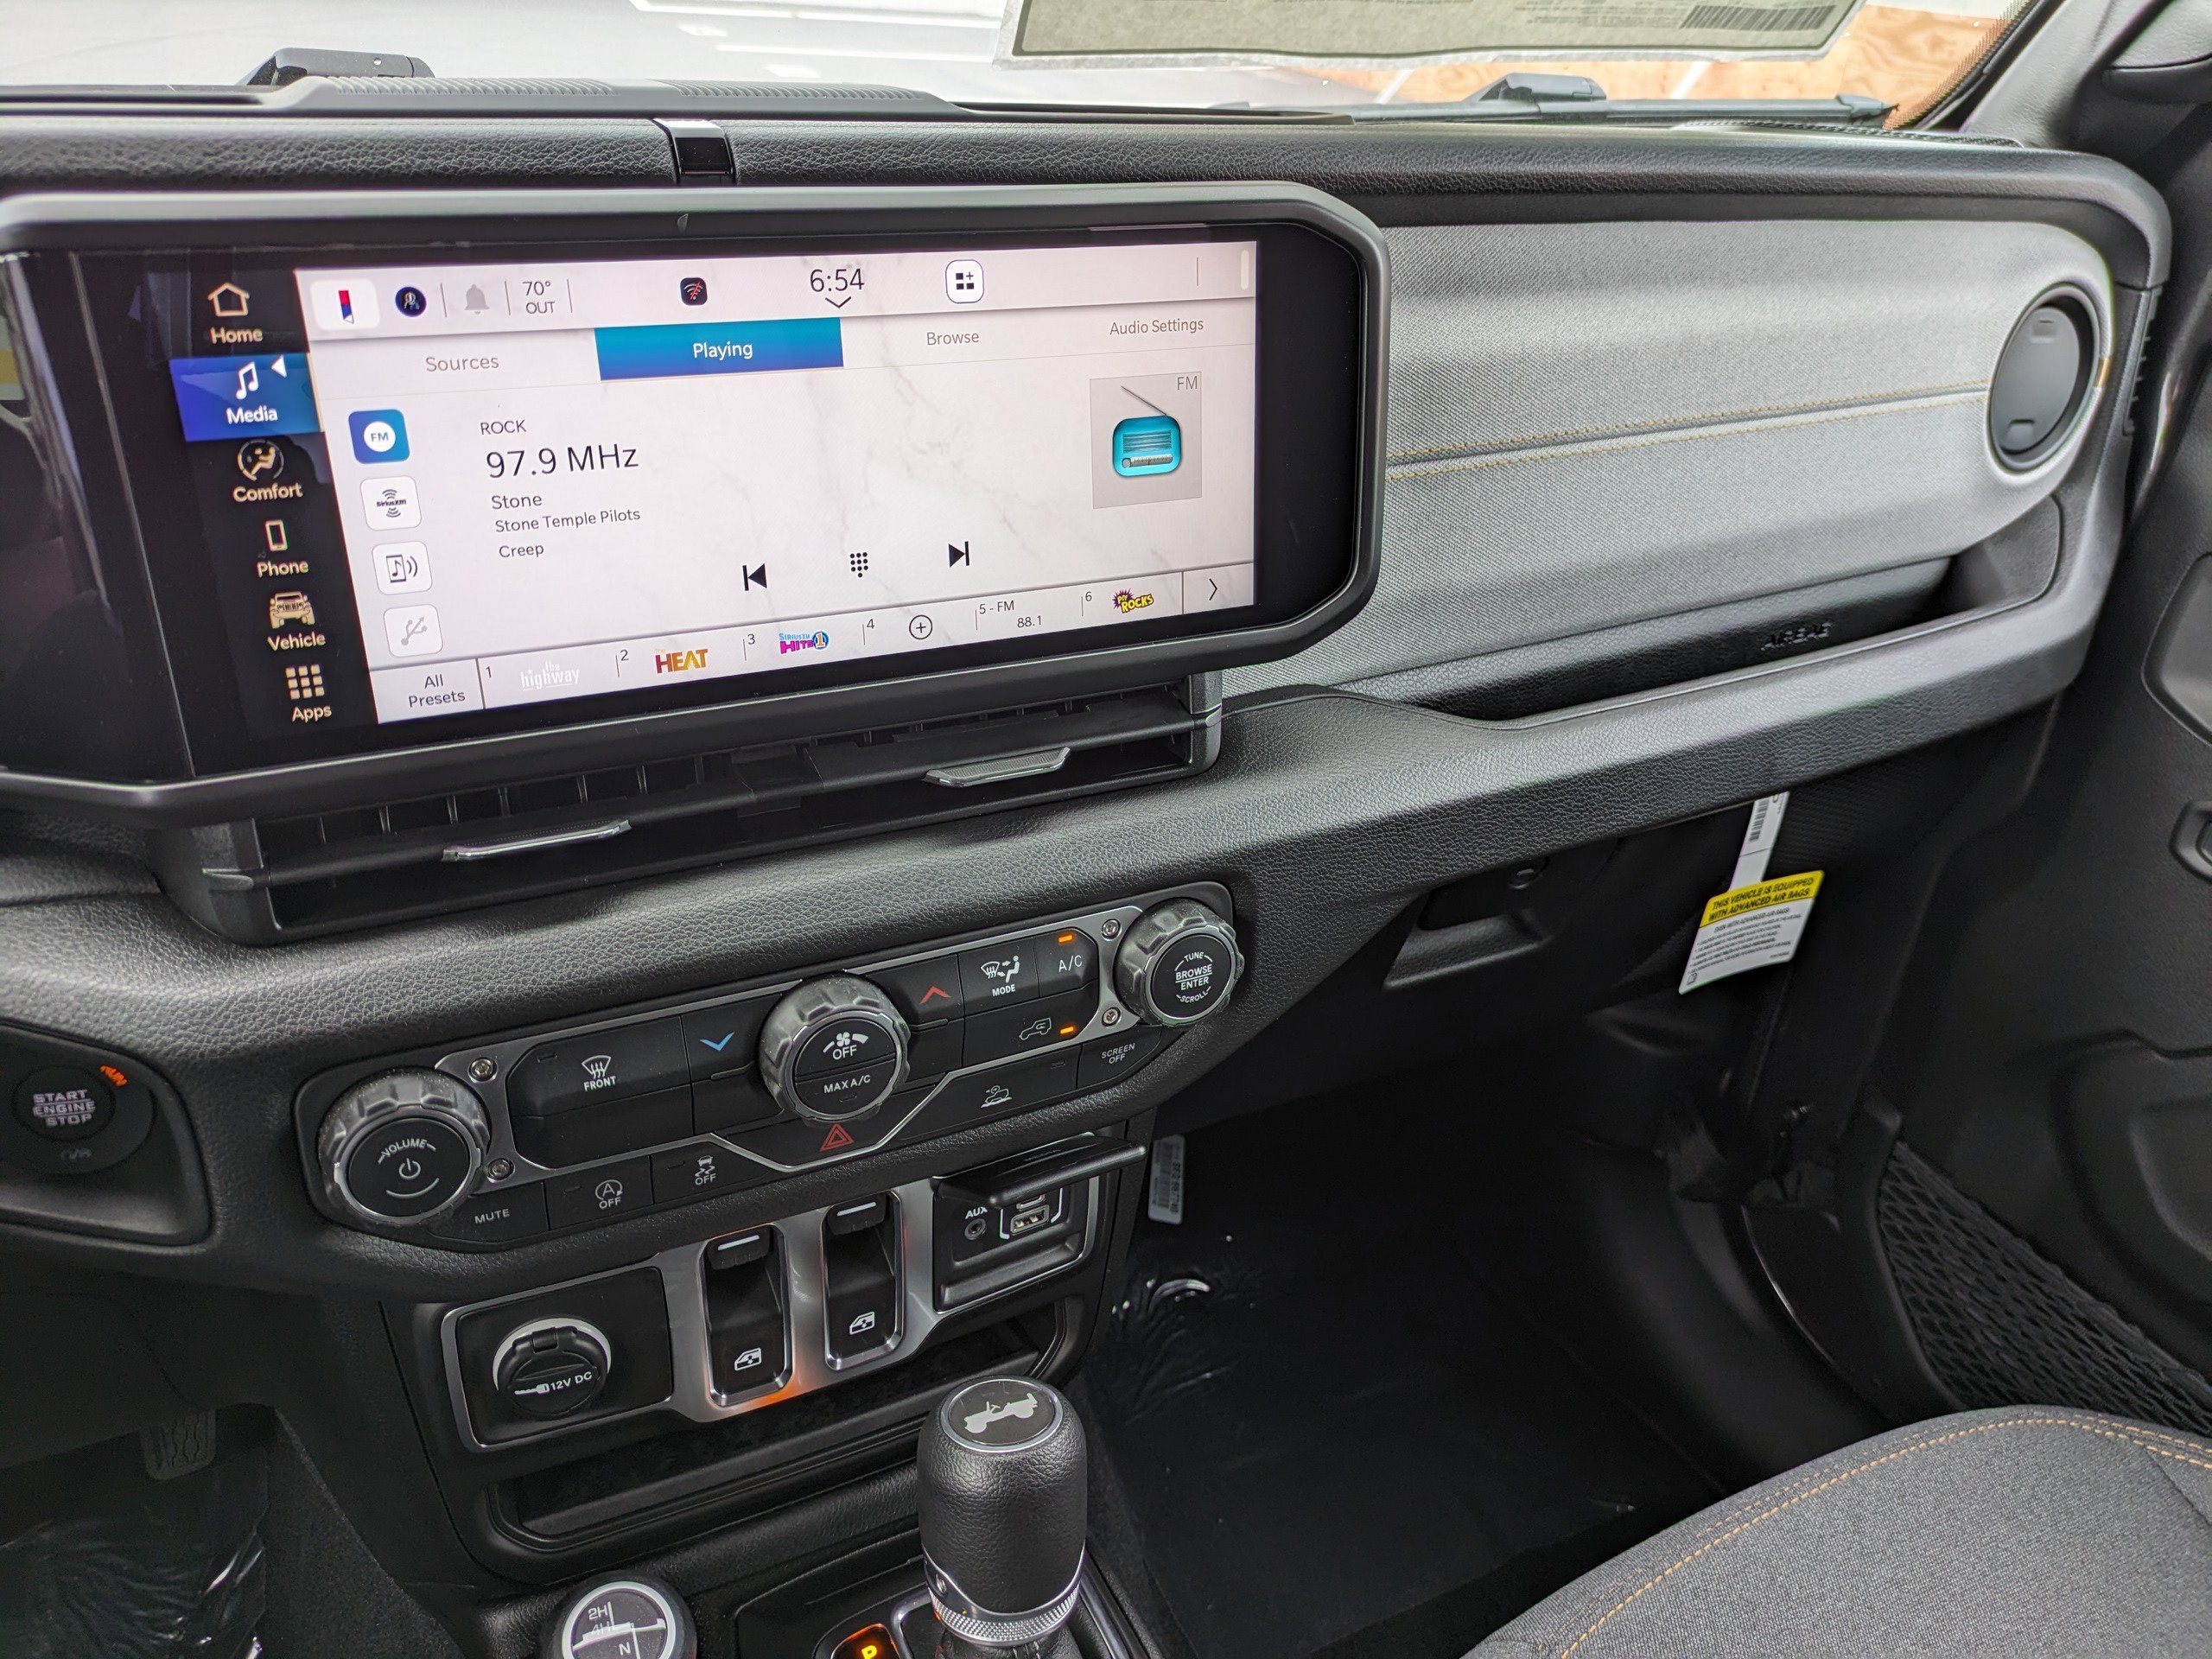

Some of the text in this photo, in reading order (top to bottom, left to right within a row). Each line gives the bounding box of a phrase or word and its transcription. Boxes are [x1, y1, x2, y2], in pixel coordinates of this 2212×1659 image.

[810, 268, 864, 292] 6:54
[525, 301, 556, 315] OUT
[1109, 317, 1205, 335] Audio Settings
[211, 327, 263, 344] Home
[926, 331, 980, 346] Browse
[692, 341, 753, 360] Playing
[425, 353, 499, 372] Sources
[1177, 376, 1198, 391] FM
[226, 406, 278, 424] Media
[480, 418, 527, 435] ROCK
[371, 432, 389, 442] FM
[486, 443, 639, 479] 97.9 MHz
[232, 482, 303, 503] Comfort
[491, 493, 543, 510] Stone
[495, 506, 641, 533] Stone Temple Pilots
[499, 543, 544, 560] Creep
[257, 558, 309, 577] Phone
[1085, 591, 1092, 601] 6
[1121, 594, 1154, 613] ROCKS
[979, 603, 987, 615] 5
[997, 601, 1014, 613] FM
[866, 619, 875, 631] 4
[1017, 615, 1042, 628] 88.1
[267, 632, 326, 652] Vehicle
[747, 633, 756, 645] 3
[815, 632, 824, 649] 1
[620, 649, 629, 661] 2
[655, 649, 708, 674] HEAT
[485, 666, 493, 679] 1
[545, 660, 560, 672] the
[424, 674, 444, 689] All
[520, 669, 580, 690] highway
[408, 690, 467, 708] Presets
[291, 705, 332, 722] Apps
[1712, 877, 1815, 910] THIS VEHICLE IS EQUIPPED
[1708, 888, 1810, 921] WITH ADVANCED AIR BAGS
[1058, 955, 1083, 972] A/C
[1184, 951, 1205, 962] TUNE
[1175, 963, 1212, 980] BROWSE
[992, 984, 1016, 996] MODE
[1180, 976, 1210, 990] ENTER
[1179, 991, 1208, 1003] SCROLL
[832, 1045, 858, 1060] OFF
[1101, 1043, 1135, 1059] SCREEN
[1109, 1052, 1126, 1064] OFF
[583, 1076, 616, 1091] FRONT
[823, 1074, 871, 1094] MAX A/C
[33, 1089, 87, 1103] START
[33, 1101, 95, 1115] ENGINE
[46, 1114, 92, 1127] STOP
[382, 1138, 428, 1158] VOLUME
[695, 1173, 716, 1186] OFF
[599, 1195, 621, 1209] OFF
[474, 1208, 510, 1225] MUTE
[965, 1206, 988, 1219] AUX
[551, 1371, 592, 1390] 12V DC
[588, 1605, 607, 1620] 2H
[618, 1642, 632, 1656] N
[861, 1645, 877, 1659] P
